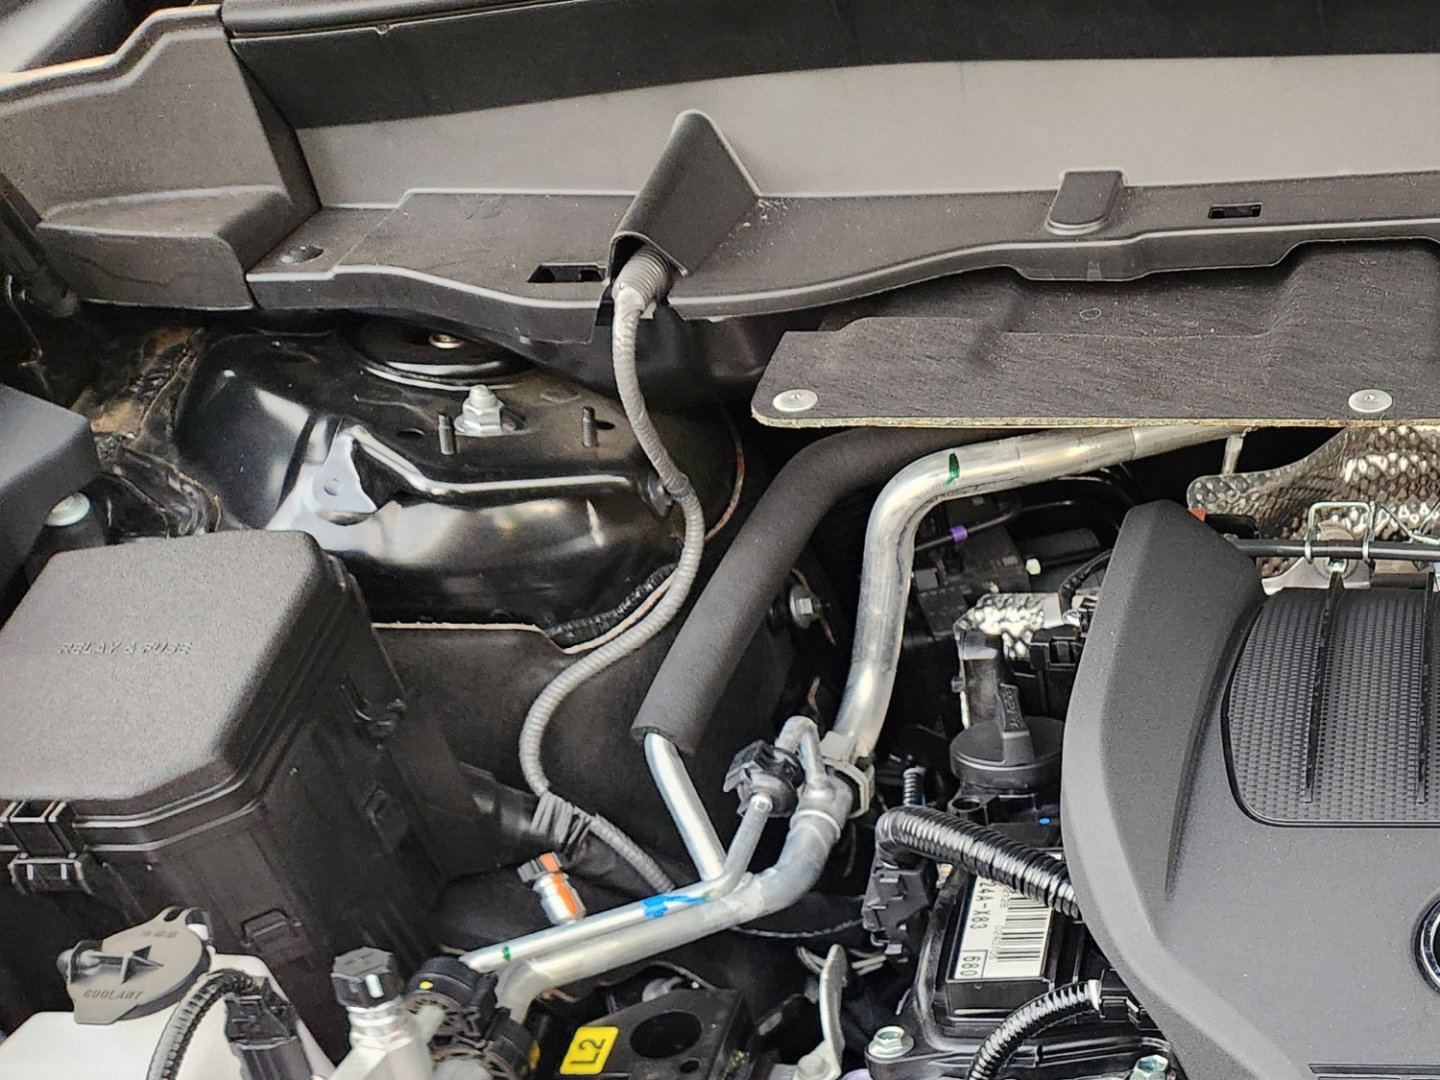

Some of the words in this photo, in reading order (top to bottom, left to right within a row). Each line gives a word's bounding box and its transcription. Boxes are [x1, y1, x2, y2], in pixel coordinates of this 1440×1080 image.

[59, 641, 121, 655] RELAY
[960, 955, 981, 977] 680
[83, 989, 145, 1001] COOLANT
[569, 1037, 607, 1066] L2
